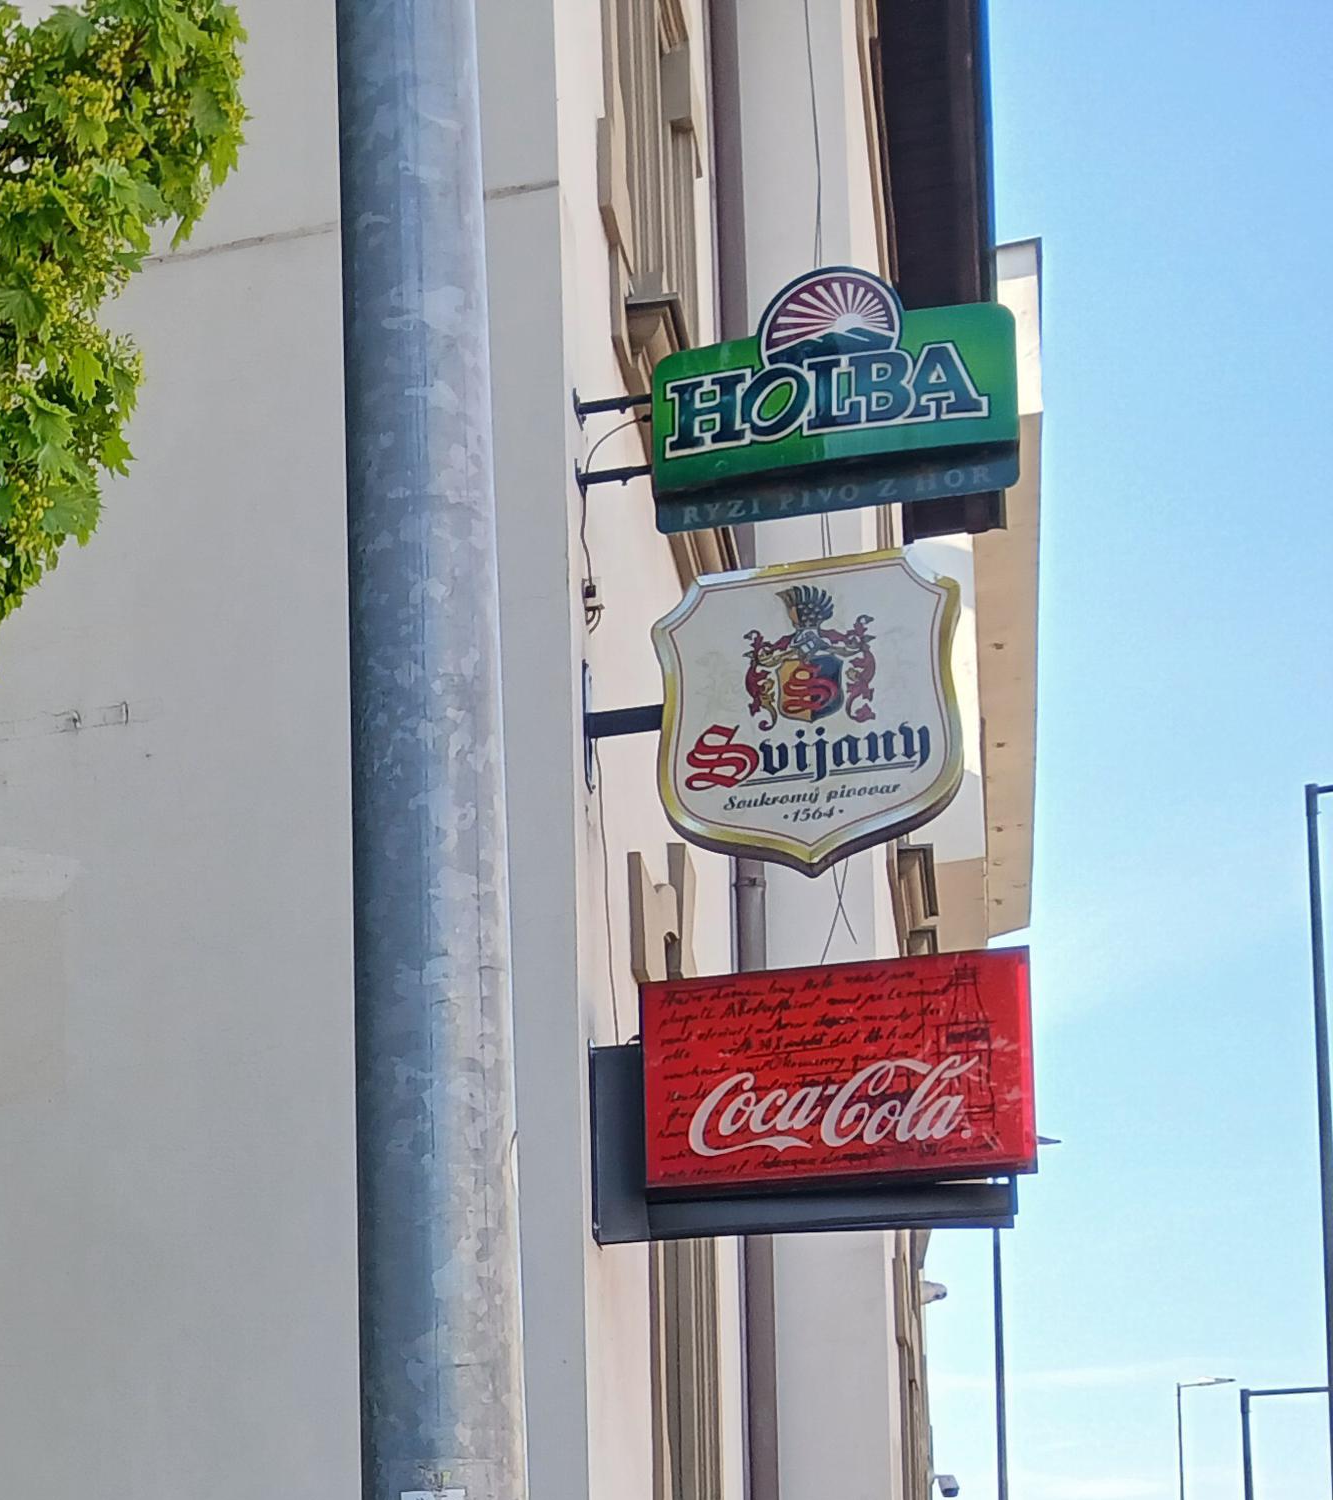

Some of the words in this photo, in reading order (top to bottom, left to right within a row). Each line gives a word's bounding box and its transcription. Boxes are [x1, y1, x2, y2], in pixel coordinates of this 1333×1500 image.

[665, 342, 990, 458] HOLBA
[779, 484, 860, 511] PIVO
[877, 479, 898, 498] Z
[916, 465, 992, 492] HOR
[685, 721, 931, 791] Svijany
[792, 806, 835, 822] 1564
[825, 783, 901, 804] pivovar
[689, 1055, 980, 1157] Coca-Cola
